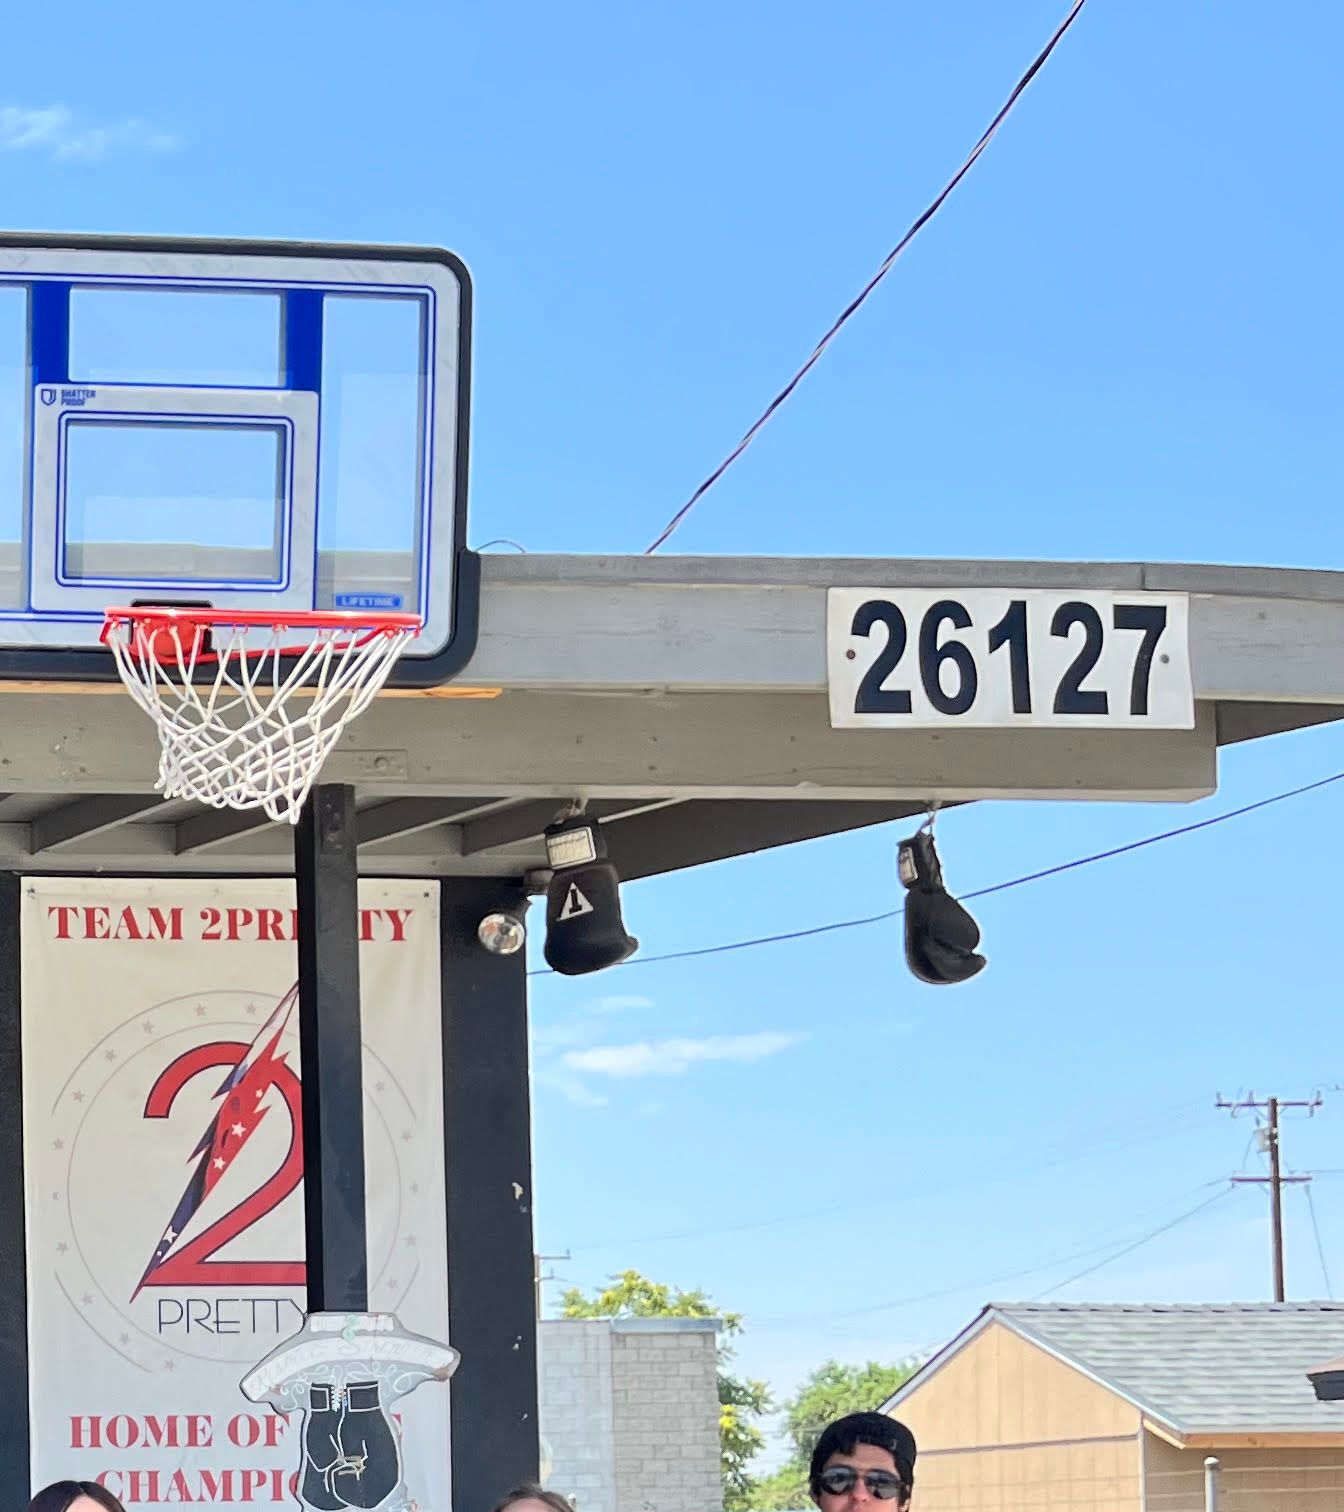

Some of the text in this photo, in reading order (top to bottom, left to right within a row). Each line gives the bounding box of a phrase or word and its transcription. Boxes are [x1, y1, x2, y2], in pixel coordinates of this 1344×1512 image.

[851, 599, 1167, 716] 26127
[47, 904, 413, 942] TEAM 2PRTY
[68, 1414, 291, 1448] HOME OF
